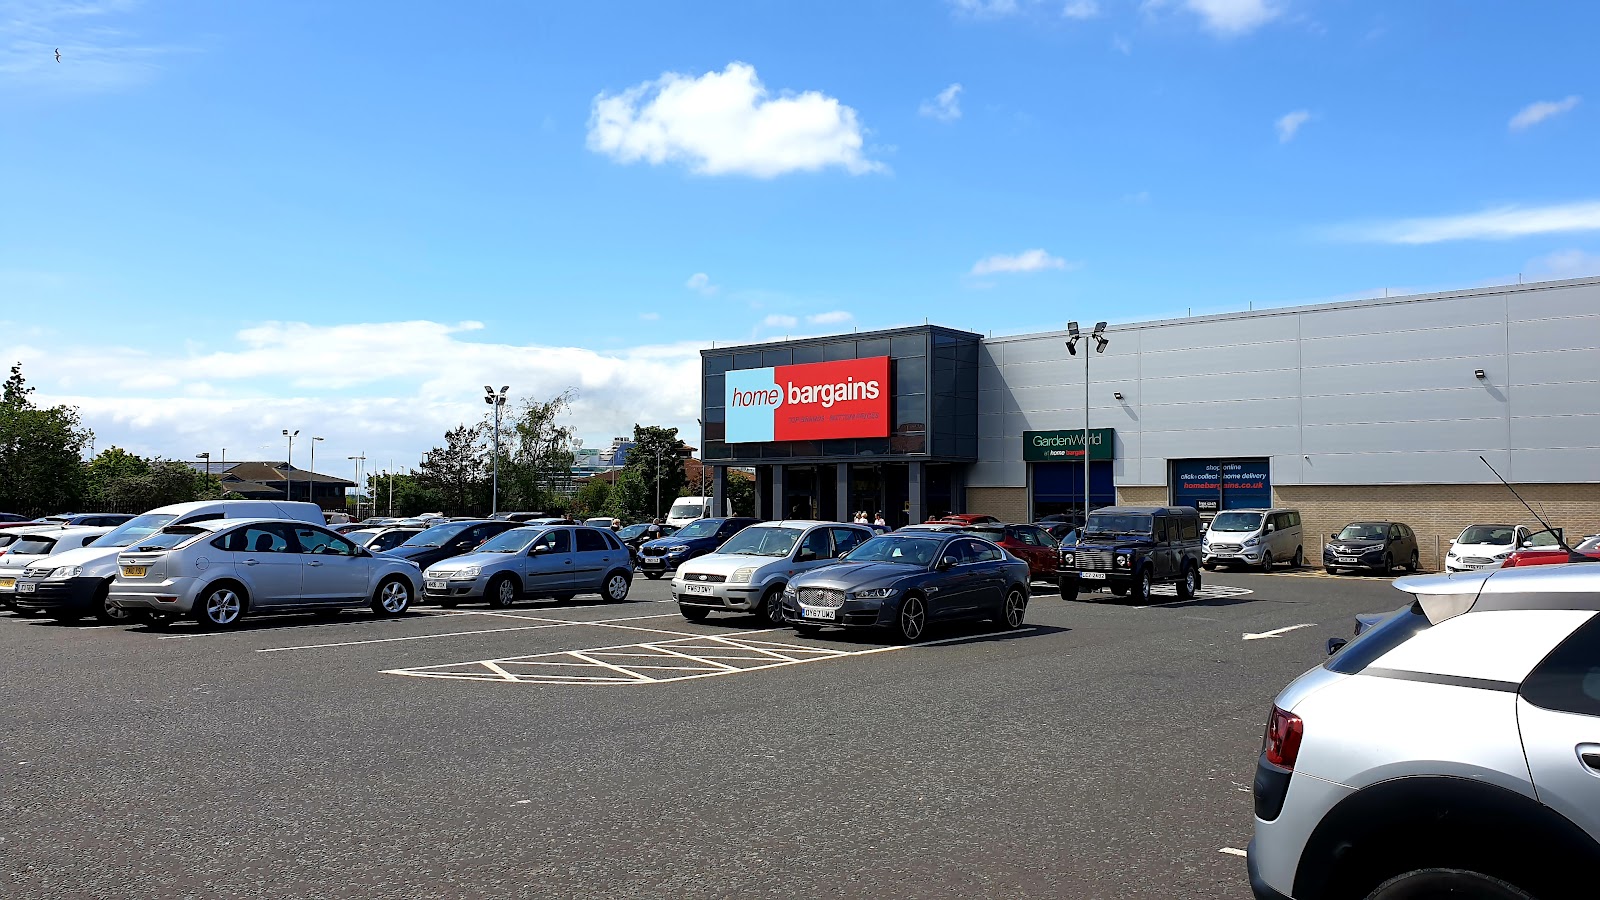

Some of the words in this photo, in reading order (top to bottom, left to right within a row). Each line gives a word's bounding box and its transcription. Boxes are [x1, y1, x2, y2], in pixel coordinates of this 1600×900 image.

[732, 387, 778, 407] home
[787, 376, 880, 408] bargains
[1241, 472, 1266, 480] delivery
